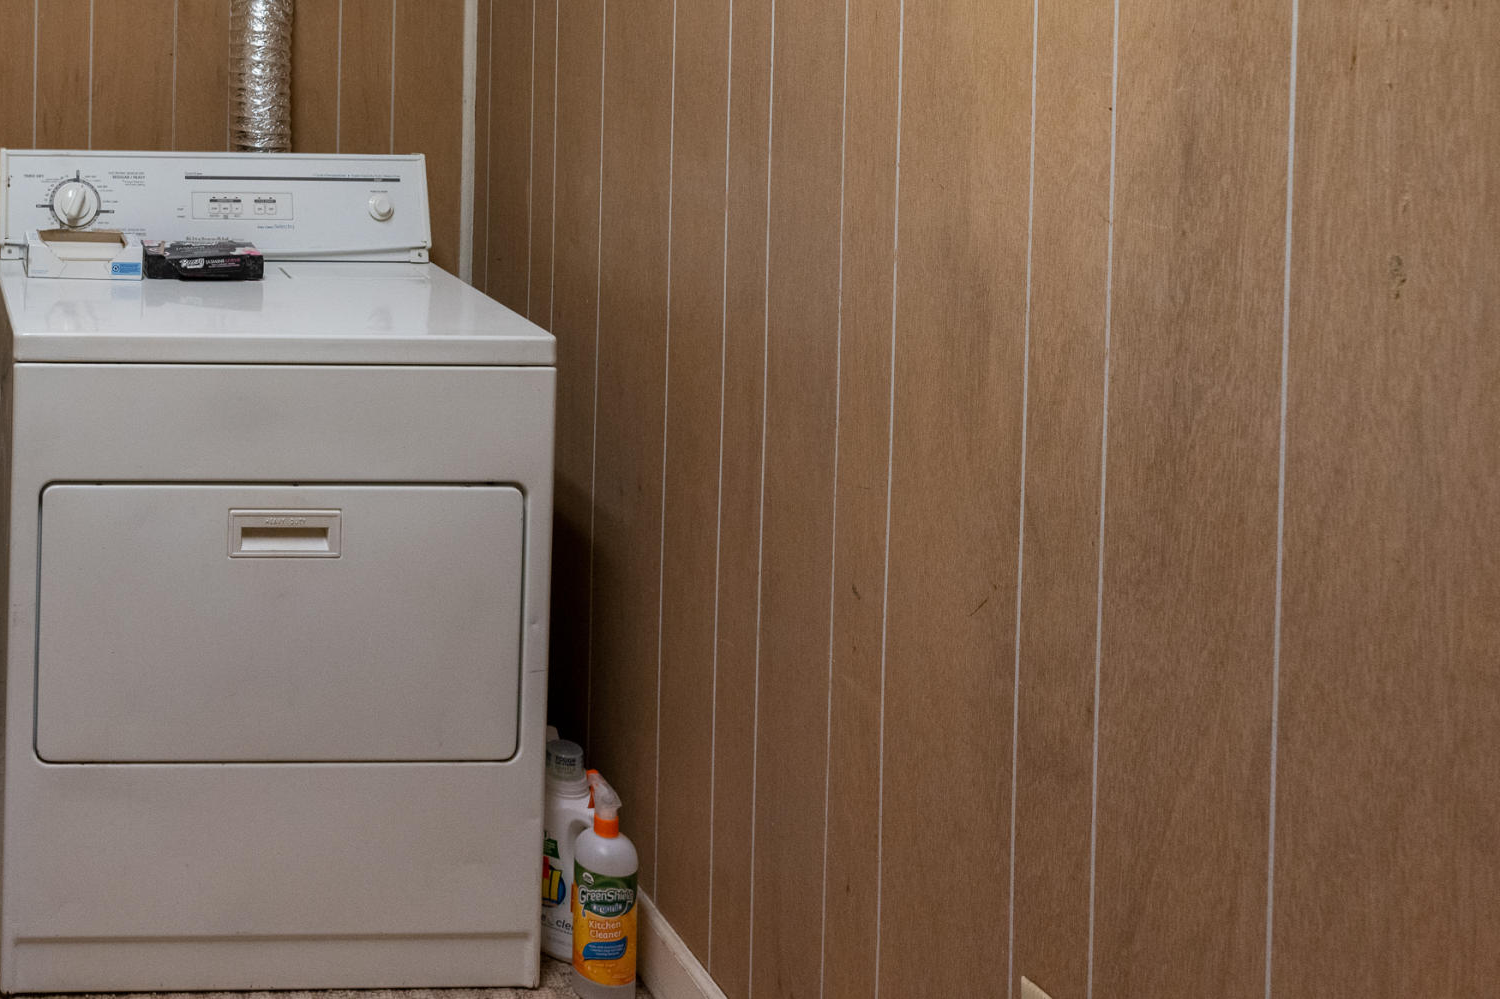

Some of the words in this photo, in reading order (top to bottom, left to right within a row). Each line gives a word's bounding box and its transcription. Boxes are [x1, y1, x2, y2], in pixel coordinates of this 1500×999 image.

[555, 920, 573, 930] cle
[588, 920, 621, 930] Kitchen
[589, 929, 622, 939] Cleaner
